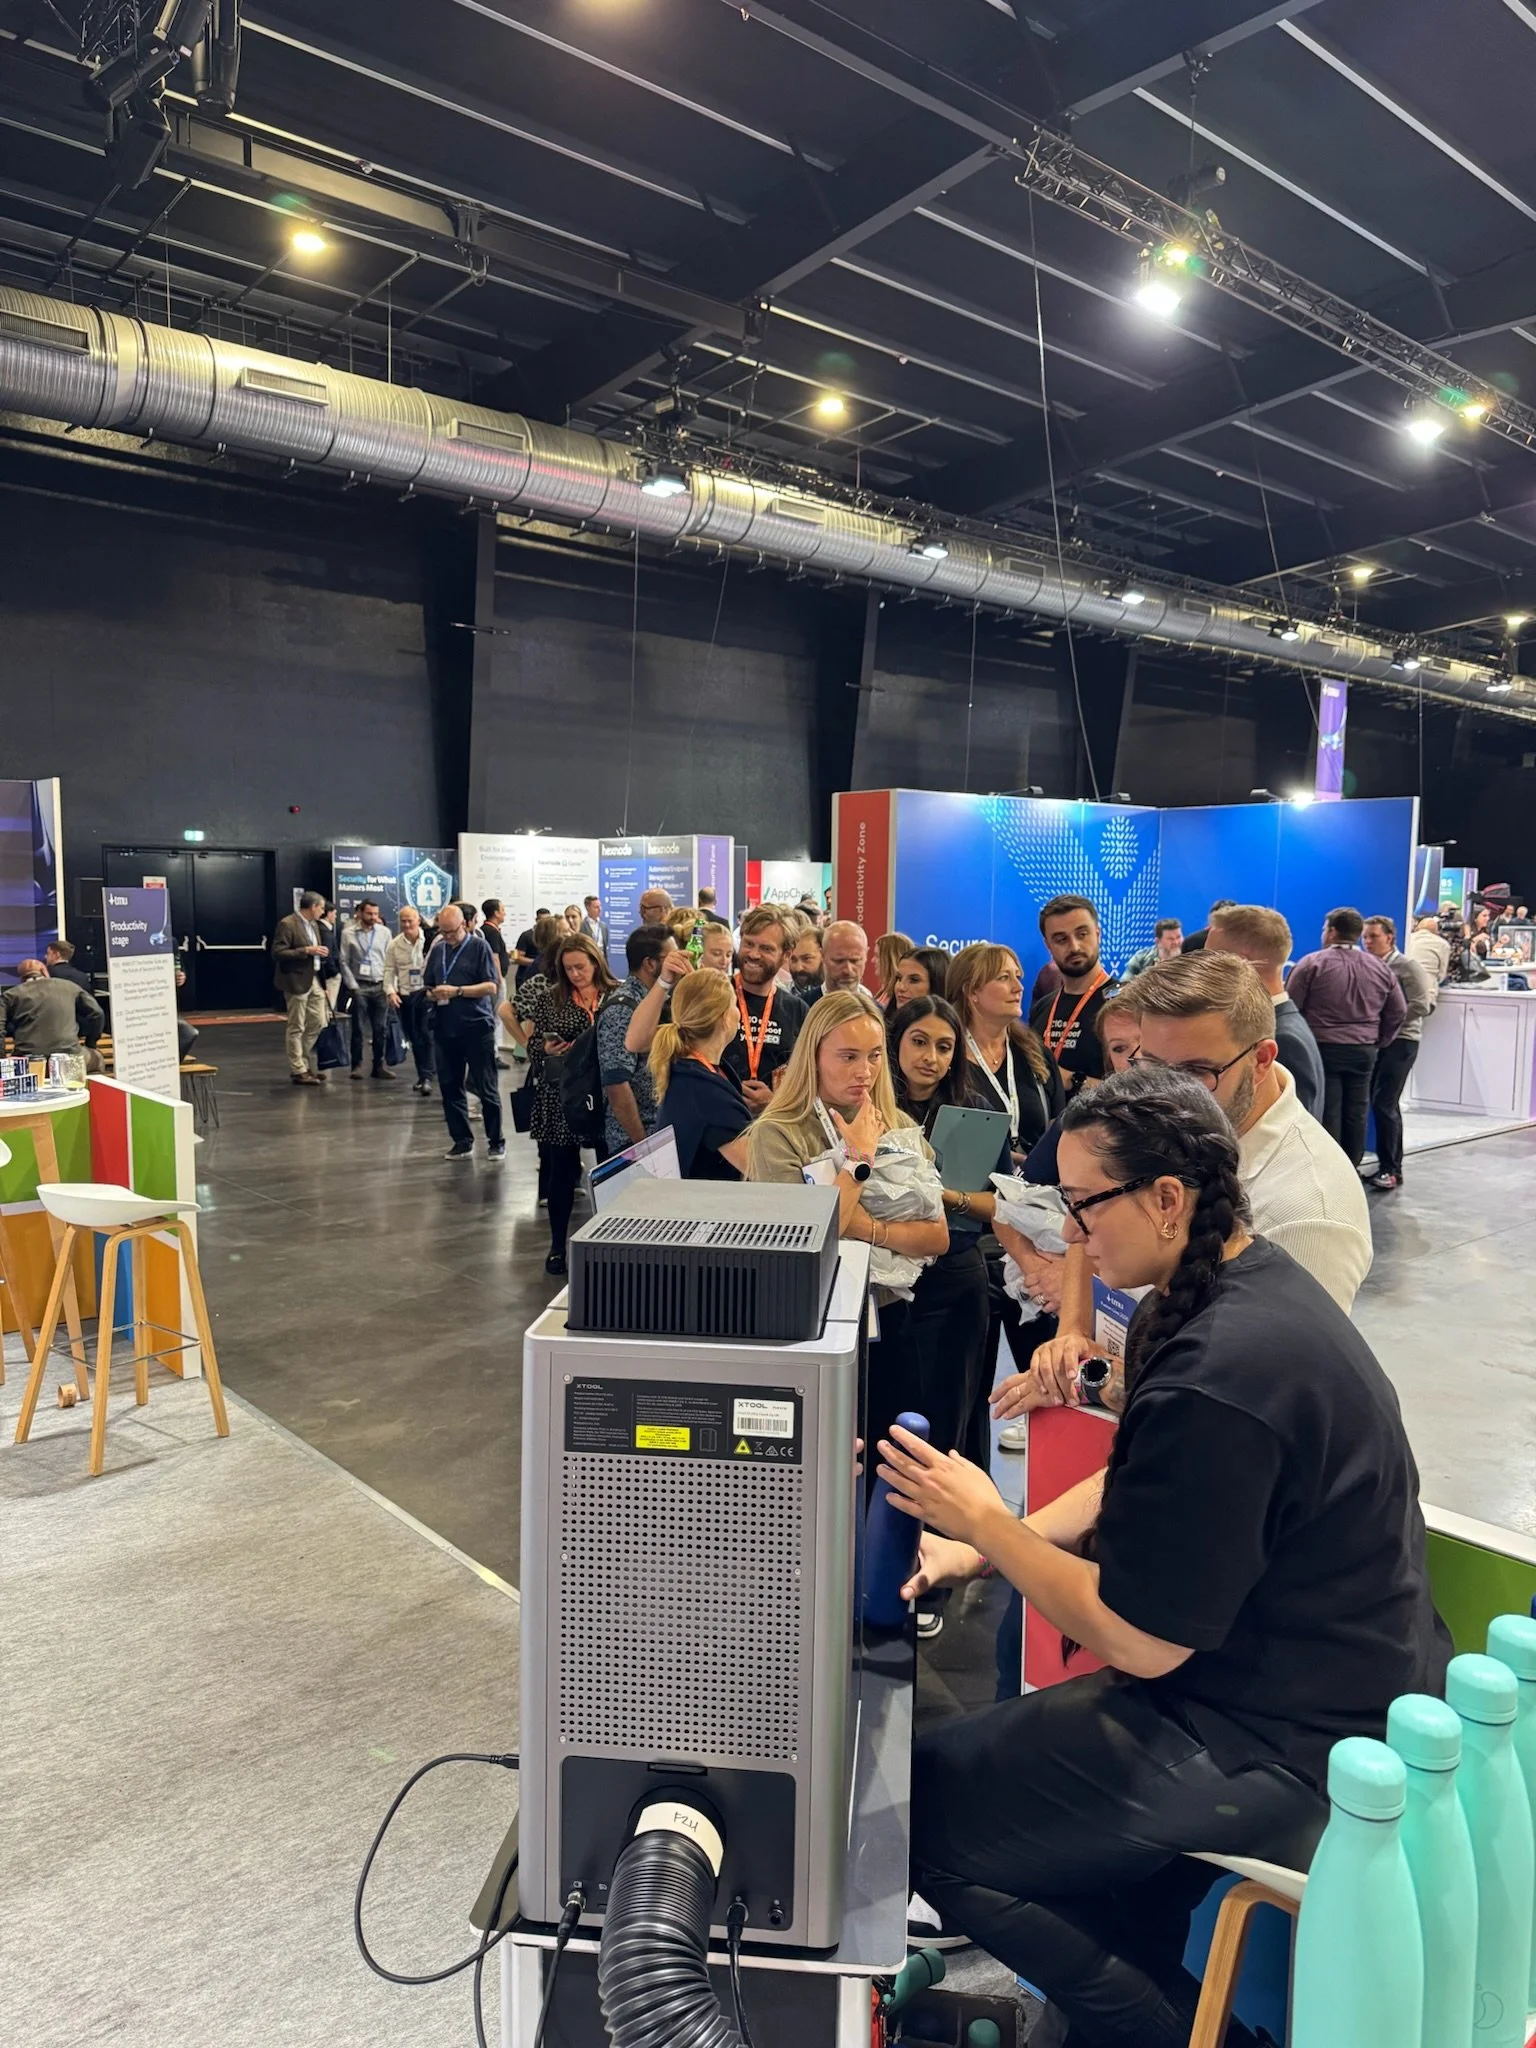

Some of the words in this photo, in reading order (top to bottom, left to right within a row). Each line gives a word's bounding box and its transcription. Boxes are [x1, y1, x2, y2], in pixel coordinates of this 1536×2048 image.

[858, 822, 867, 854] Zone
[601, 843, 633, 857] hexnode
[647, 842, 680, 856] hexnode
[337, 874, 367, 886] Security
[367, 875, 377, 884] for
[377, 875, 397, 885] What
[338, 884, 365, 892] Matters
[366, 884, 384, 892] Most
[856, 857, 866, 928] roductivity
[110, 920, 148, 932] Productivity
[111, 936, 130, 947] stage
[925, 933, 989, 957] Secu
[738, 1401, 768, 1409] XTOOL
